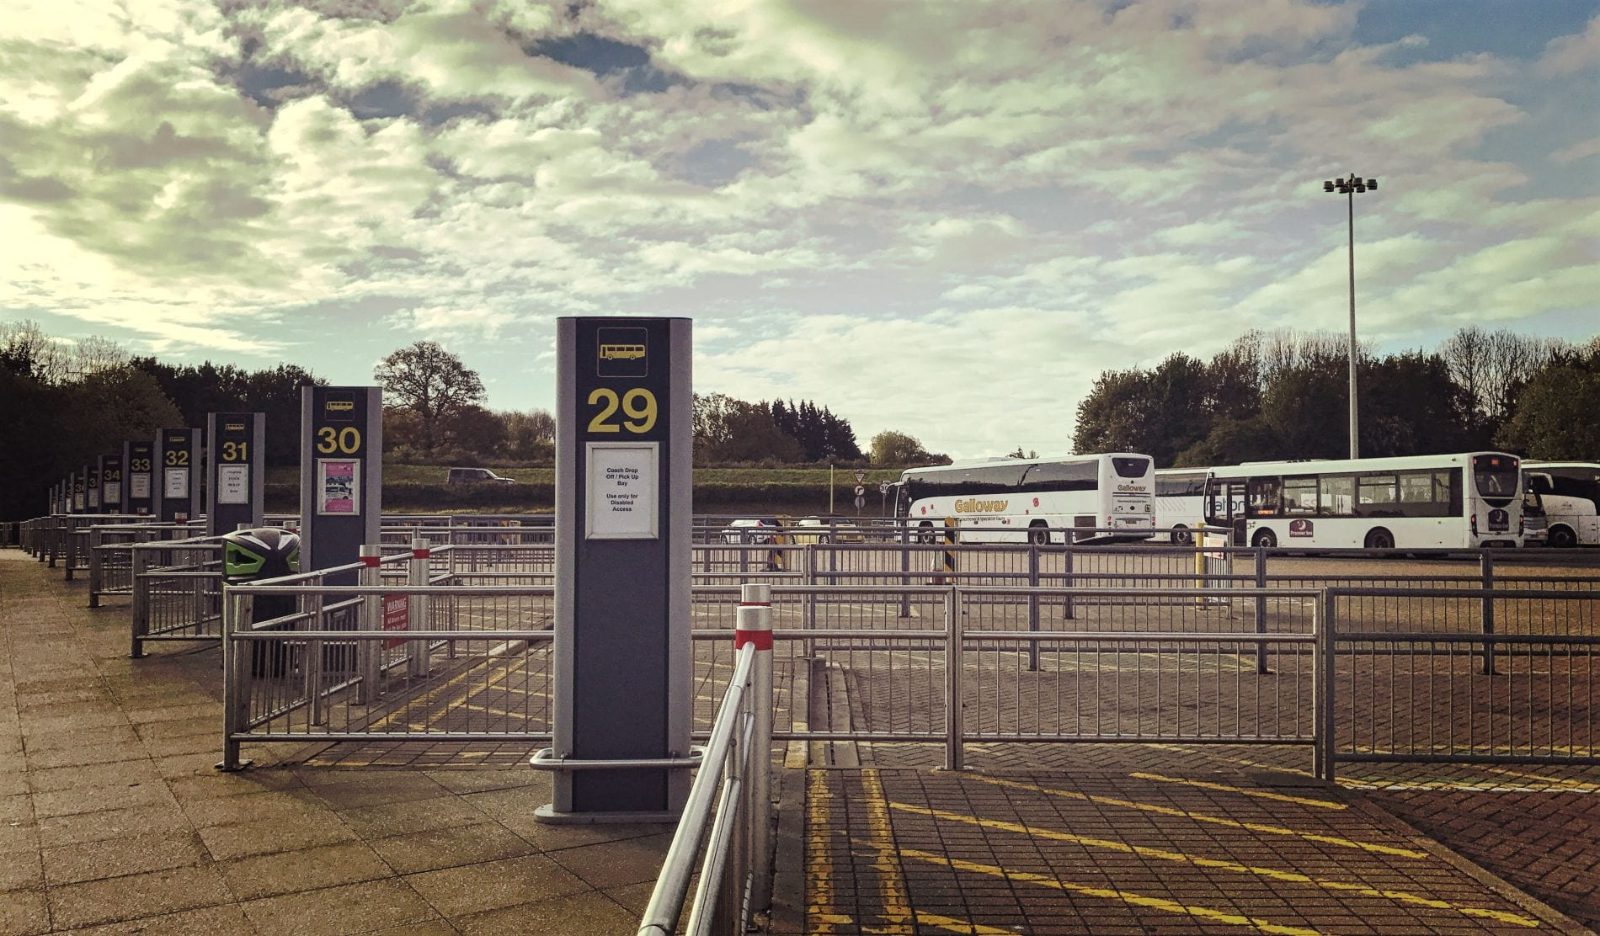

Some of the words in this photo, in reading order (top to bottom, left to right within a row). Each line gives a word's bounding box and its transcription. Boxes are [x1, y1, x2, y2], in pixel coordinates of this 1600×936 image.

[587, 387, 658, 434] 29
[317, 426, 361, 454] 30
[165, 450, 189, 466] 32
[222, 441, 247, 461] 31
[131, 458, 151, 471] 33
[103, 470, 120, 481] 34
[954, 498, 1008, 513] Galloway
[387, 597, 407, 612] WARNING
